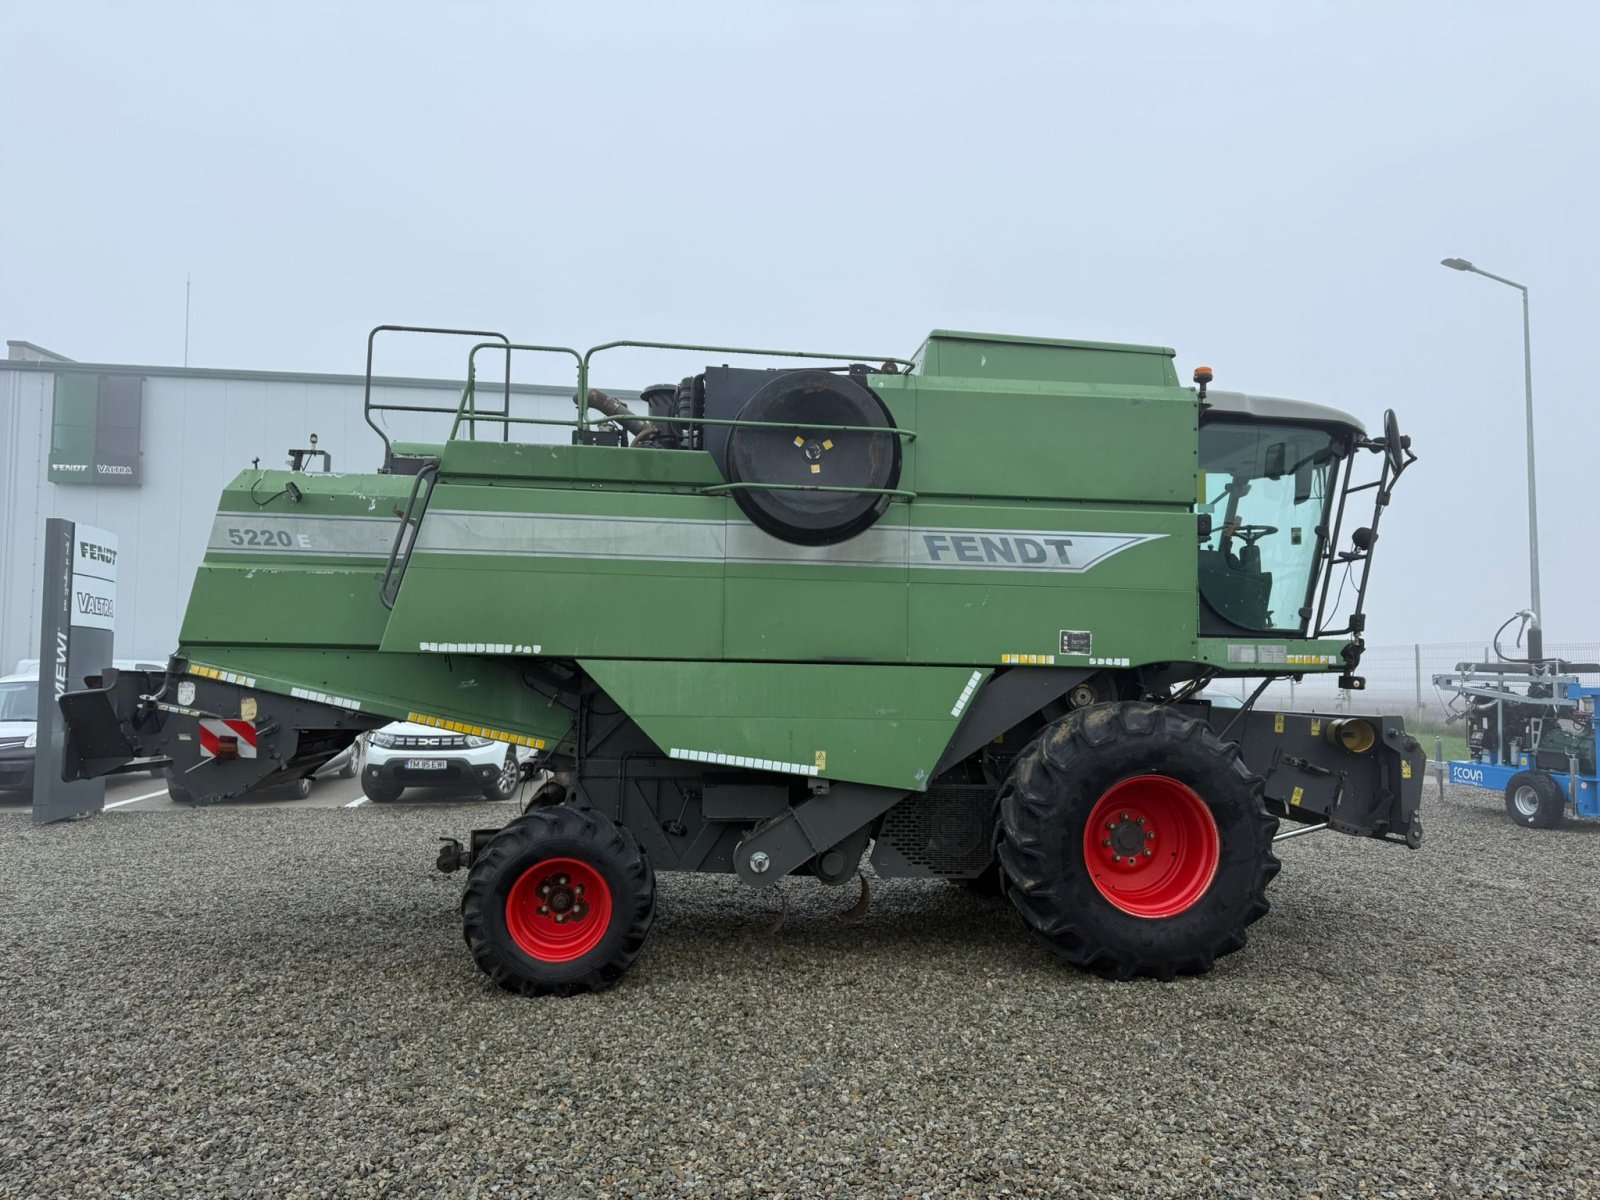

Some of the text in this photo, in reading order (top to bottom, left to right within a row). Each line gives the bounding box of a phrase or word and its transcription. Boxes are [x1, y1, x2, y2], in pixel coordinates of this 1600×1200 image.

[52, 464, 88, 472] FENDT
[97, 465, 132, 474] VALTRA
[228, 529, 312, 548] 5220 E
[80, 541, 117, 565] FENDT
[923, 535, 1073, 565] FENDT
[77, 591, 114, 618] VALTRA
[54, 631, 68, 701] MEWI
[1453, 766, 1483, 782] SCOVA
